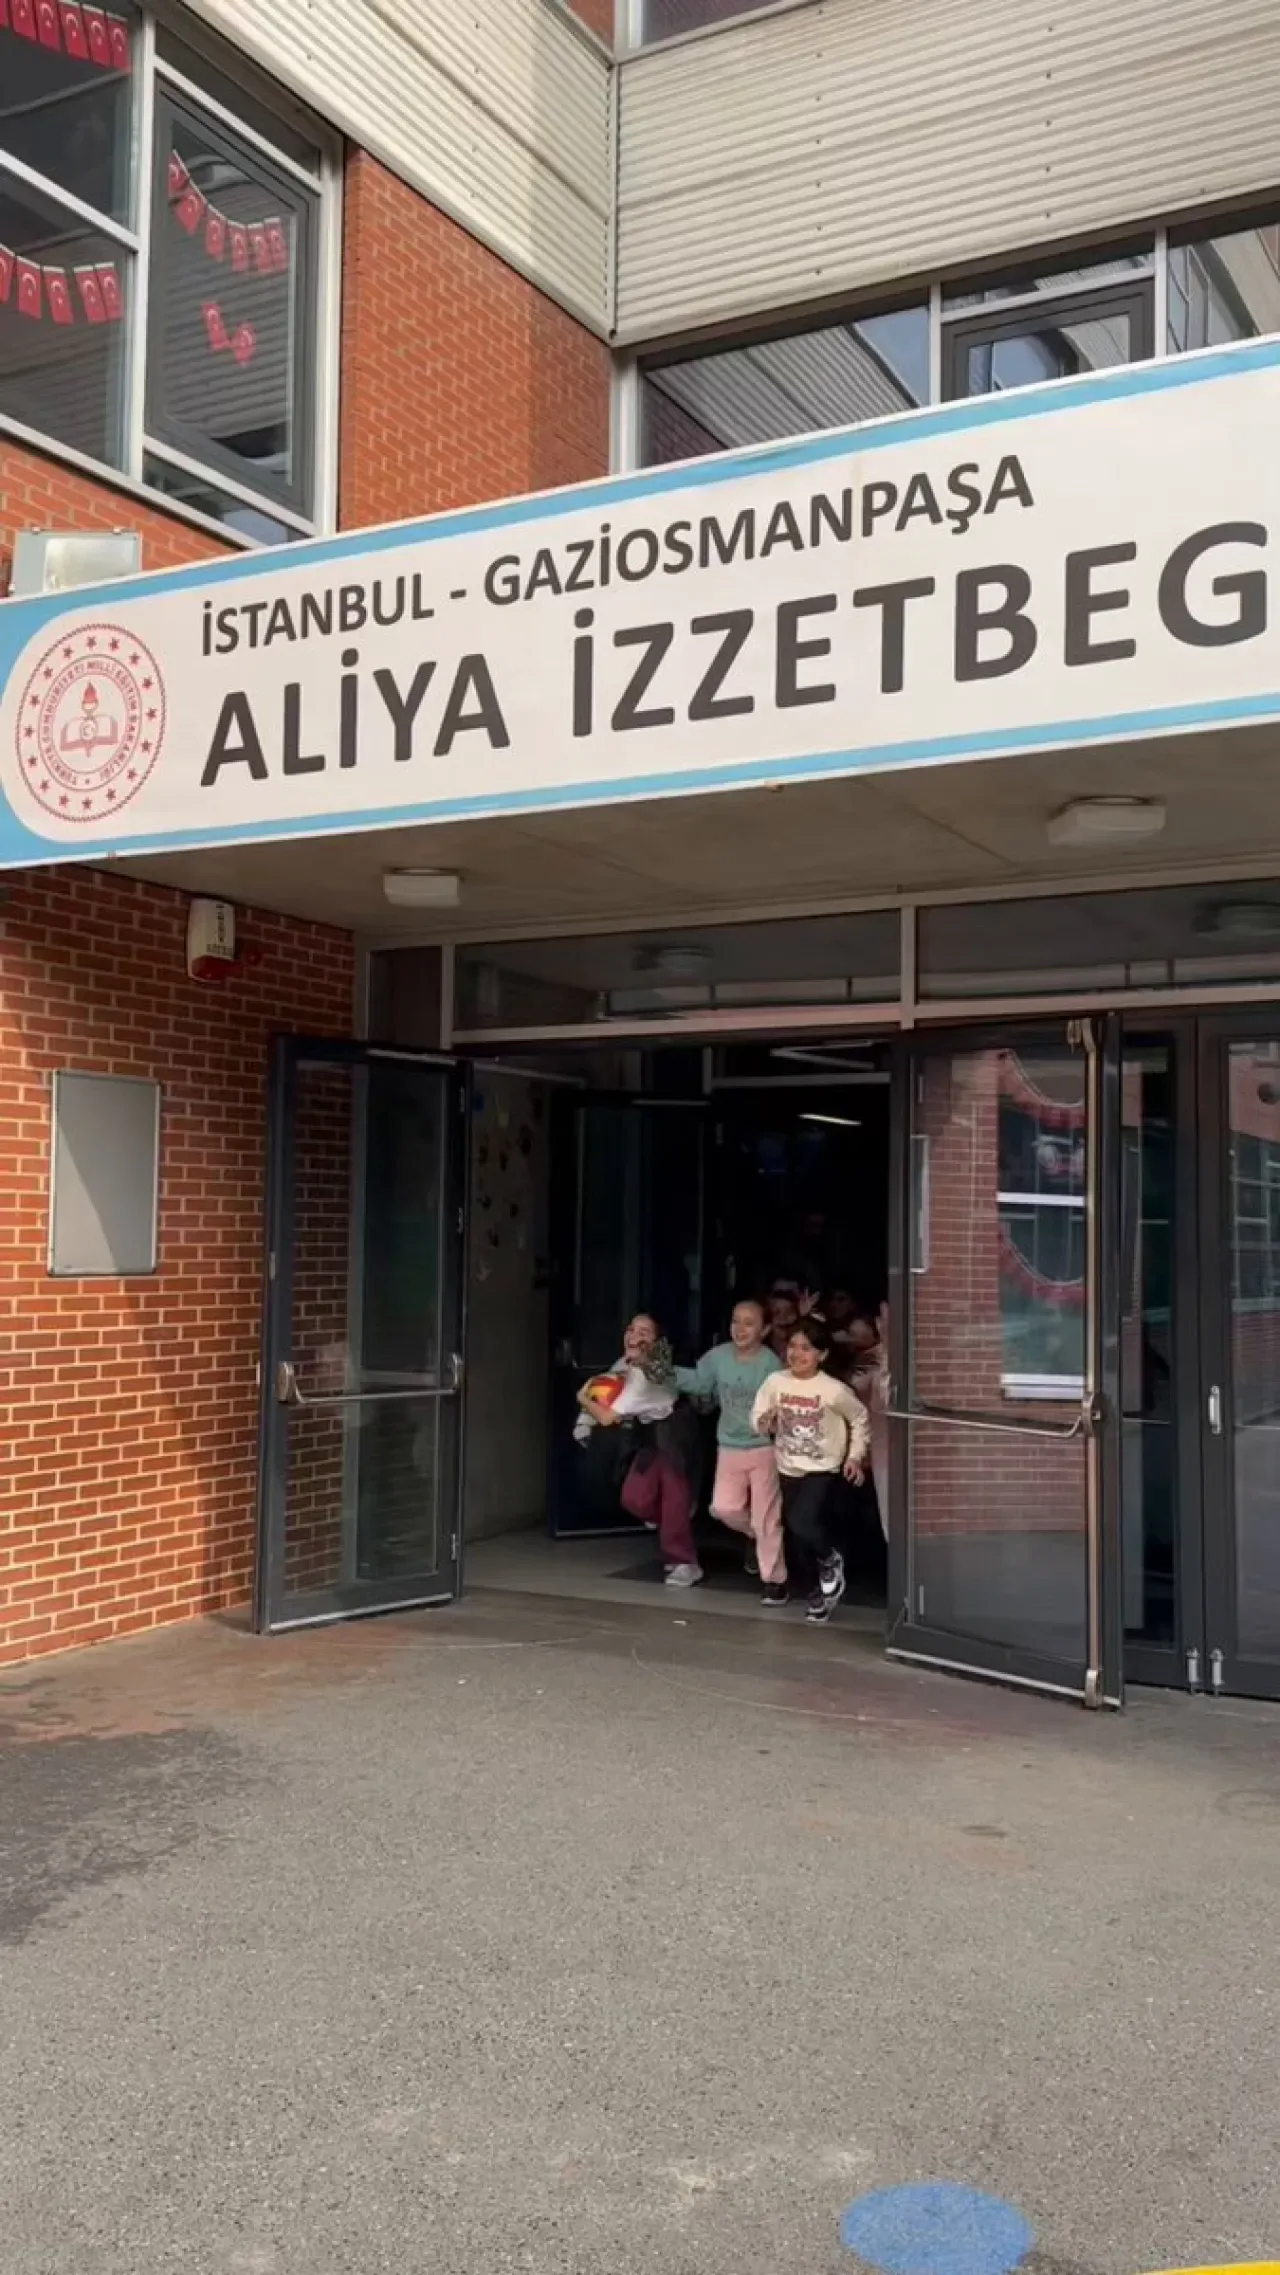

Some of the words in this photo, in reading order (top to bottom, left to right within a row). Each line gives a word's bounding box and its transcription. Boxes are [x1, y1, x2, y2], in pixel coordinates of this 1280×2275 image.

[200, 647, 511, 788] ALİYA
[572, 521, 1268, 738] İZZETBEG
[202, 573, 435, 657] İSTANBUL
[484, 454, 1034, 606] GAZİOSMANPAŞA
